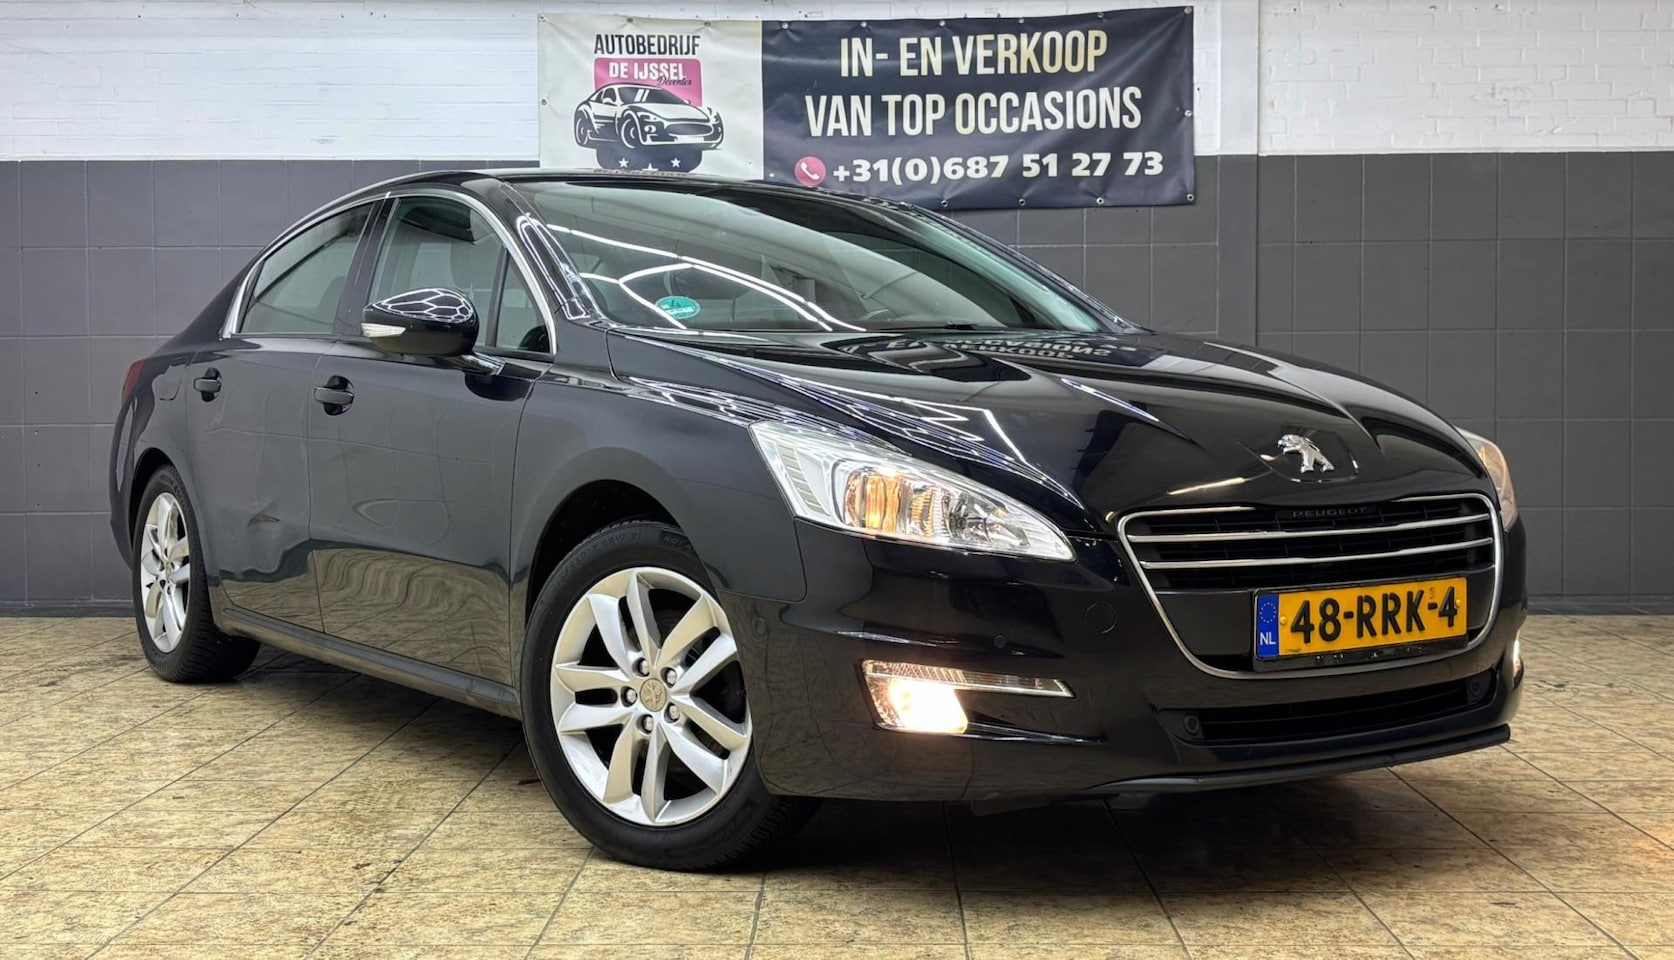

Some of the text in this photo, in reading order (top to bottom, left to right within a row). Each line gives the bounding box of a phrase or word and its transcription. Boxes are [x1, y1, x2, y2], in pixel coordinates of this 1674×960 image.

[594, 33, 701, 56] AUTOBEDRIJF
[840, 29, 1108, 77] IN- EN VERKOOP
[609, 62, 688, 80] DE IJSSEL
[805, 86, 1143, 137] VAN TOP OCCASIONS
[832, 151, 1164, 185] +31(0)687 51 27 73
[1291, 506, 1369, 518] PEUGEOT
[1290, 585, 1458, 644] 48-RRK-4
[1259, 631, 1277, 646] NL
